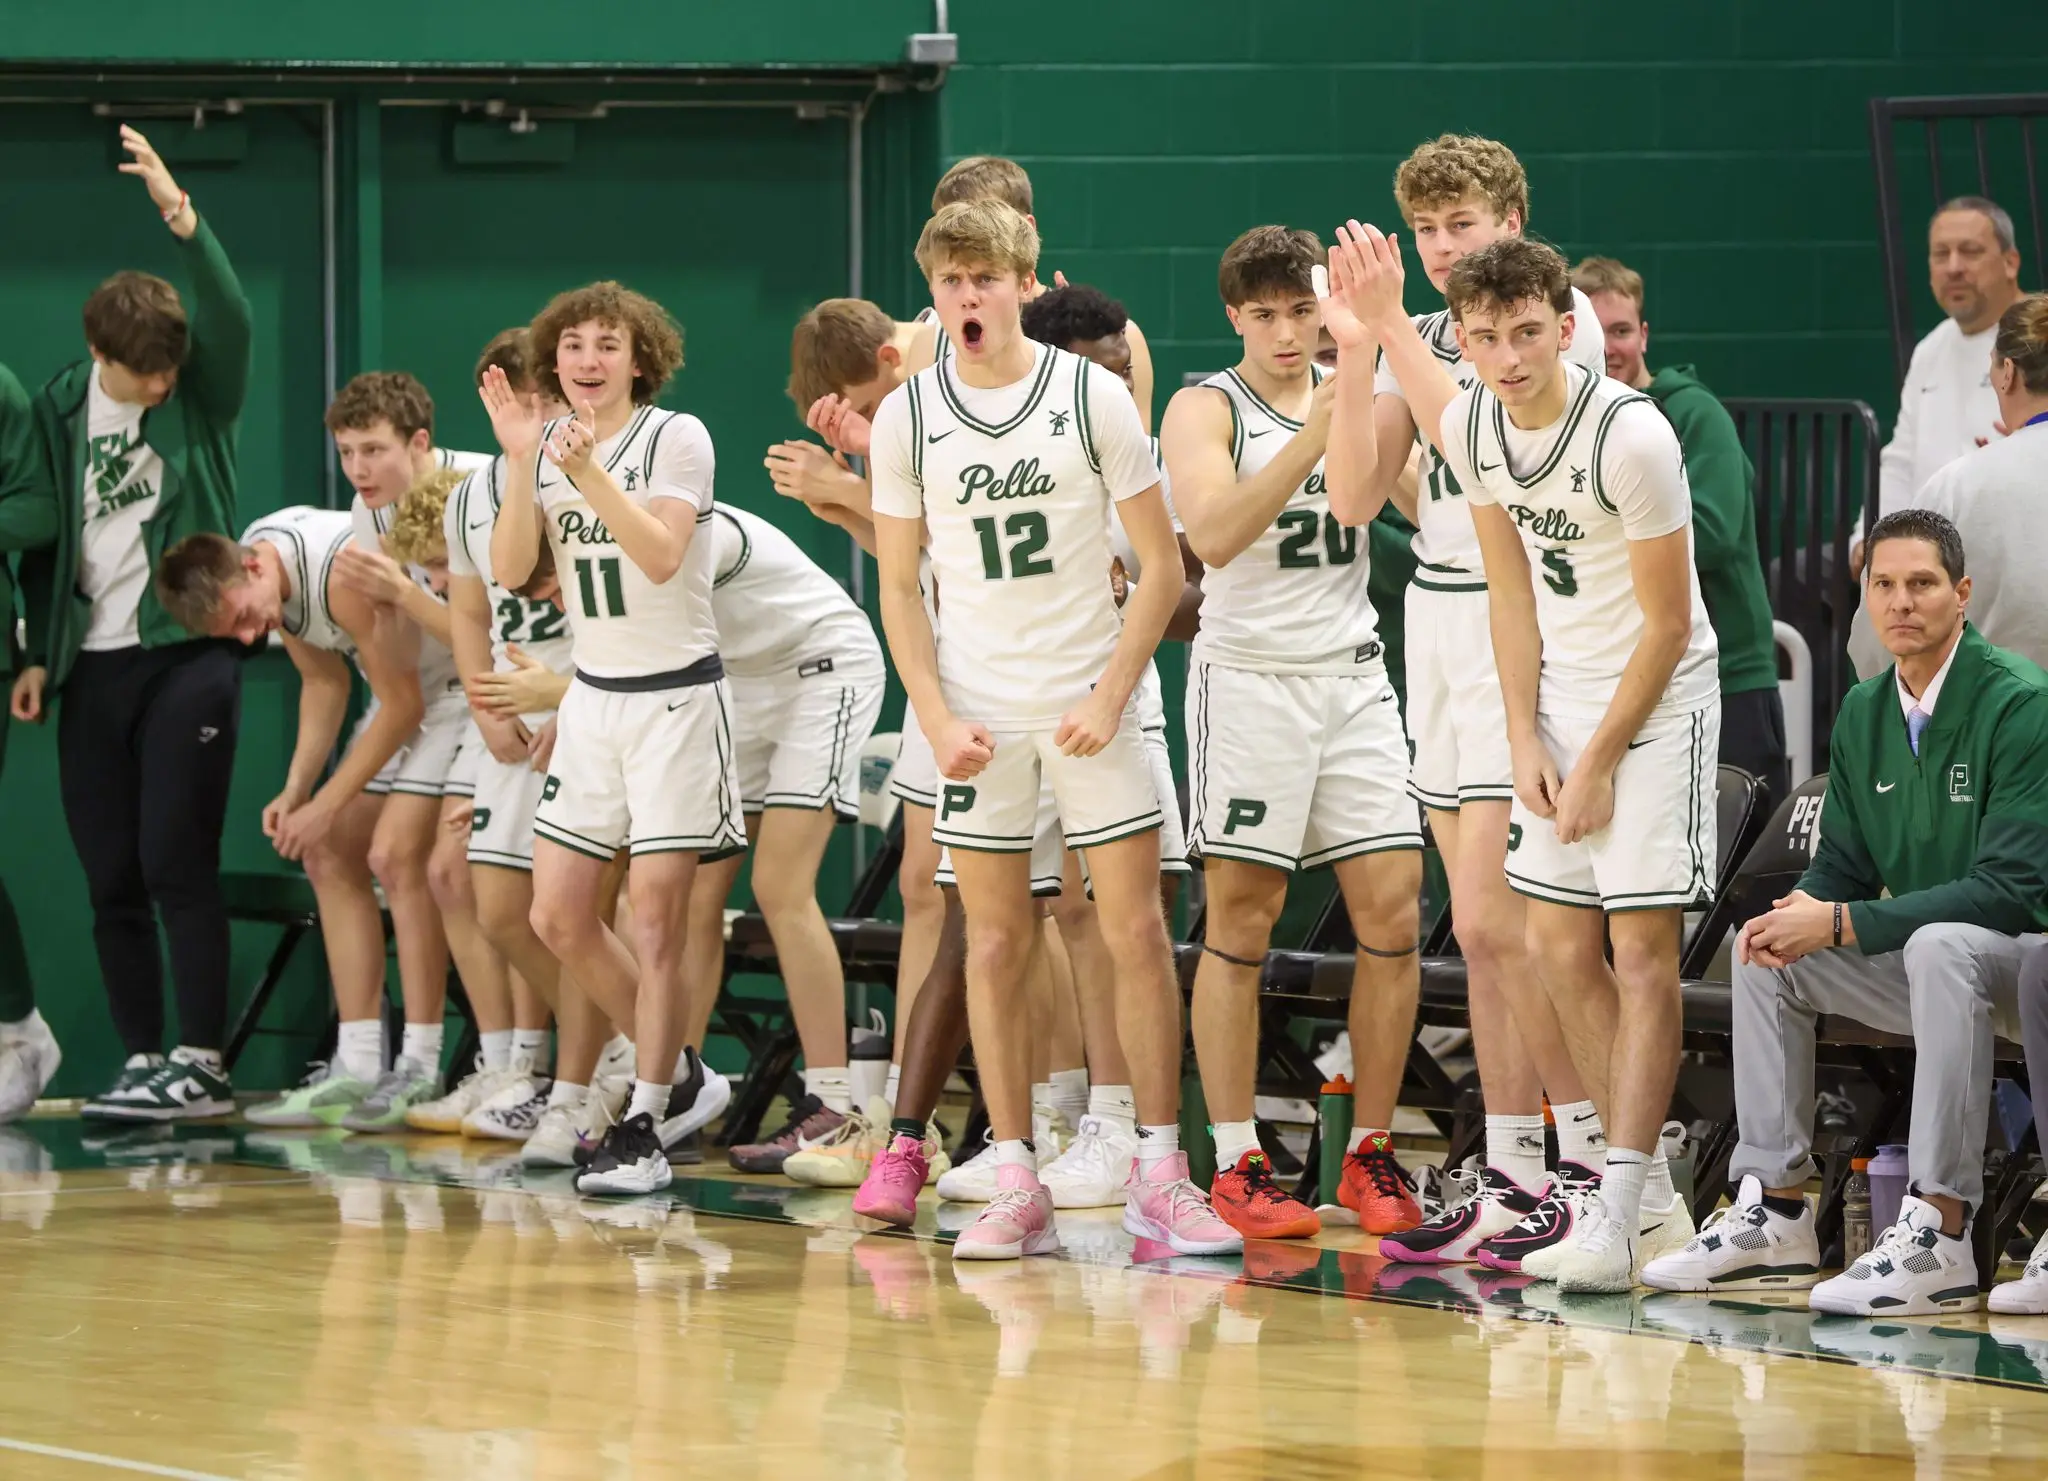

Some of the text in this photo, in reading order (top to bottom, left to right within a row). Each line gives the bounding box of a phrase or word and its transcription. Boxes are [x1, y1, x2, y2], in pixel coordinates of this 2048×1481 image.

[956, 457, 1056, 505] Pella
[558, 510, 617, 545] Pell
[1277, 509, 1357, 569] 20
[1508, 504, 1585, 541] Pella
[971, 509, 1055, 581] 12
[574, 557, 627, 618] 11
[1536, 545, 1579, 597] 5
[497, 598, 566, 642] 22
[1950, 764, 1968, 794] P
[941, 784, 976, 821] P
[1223, 798, 1267, 835] P
[1786, 795, 1822, 834] PE
